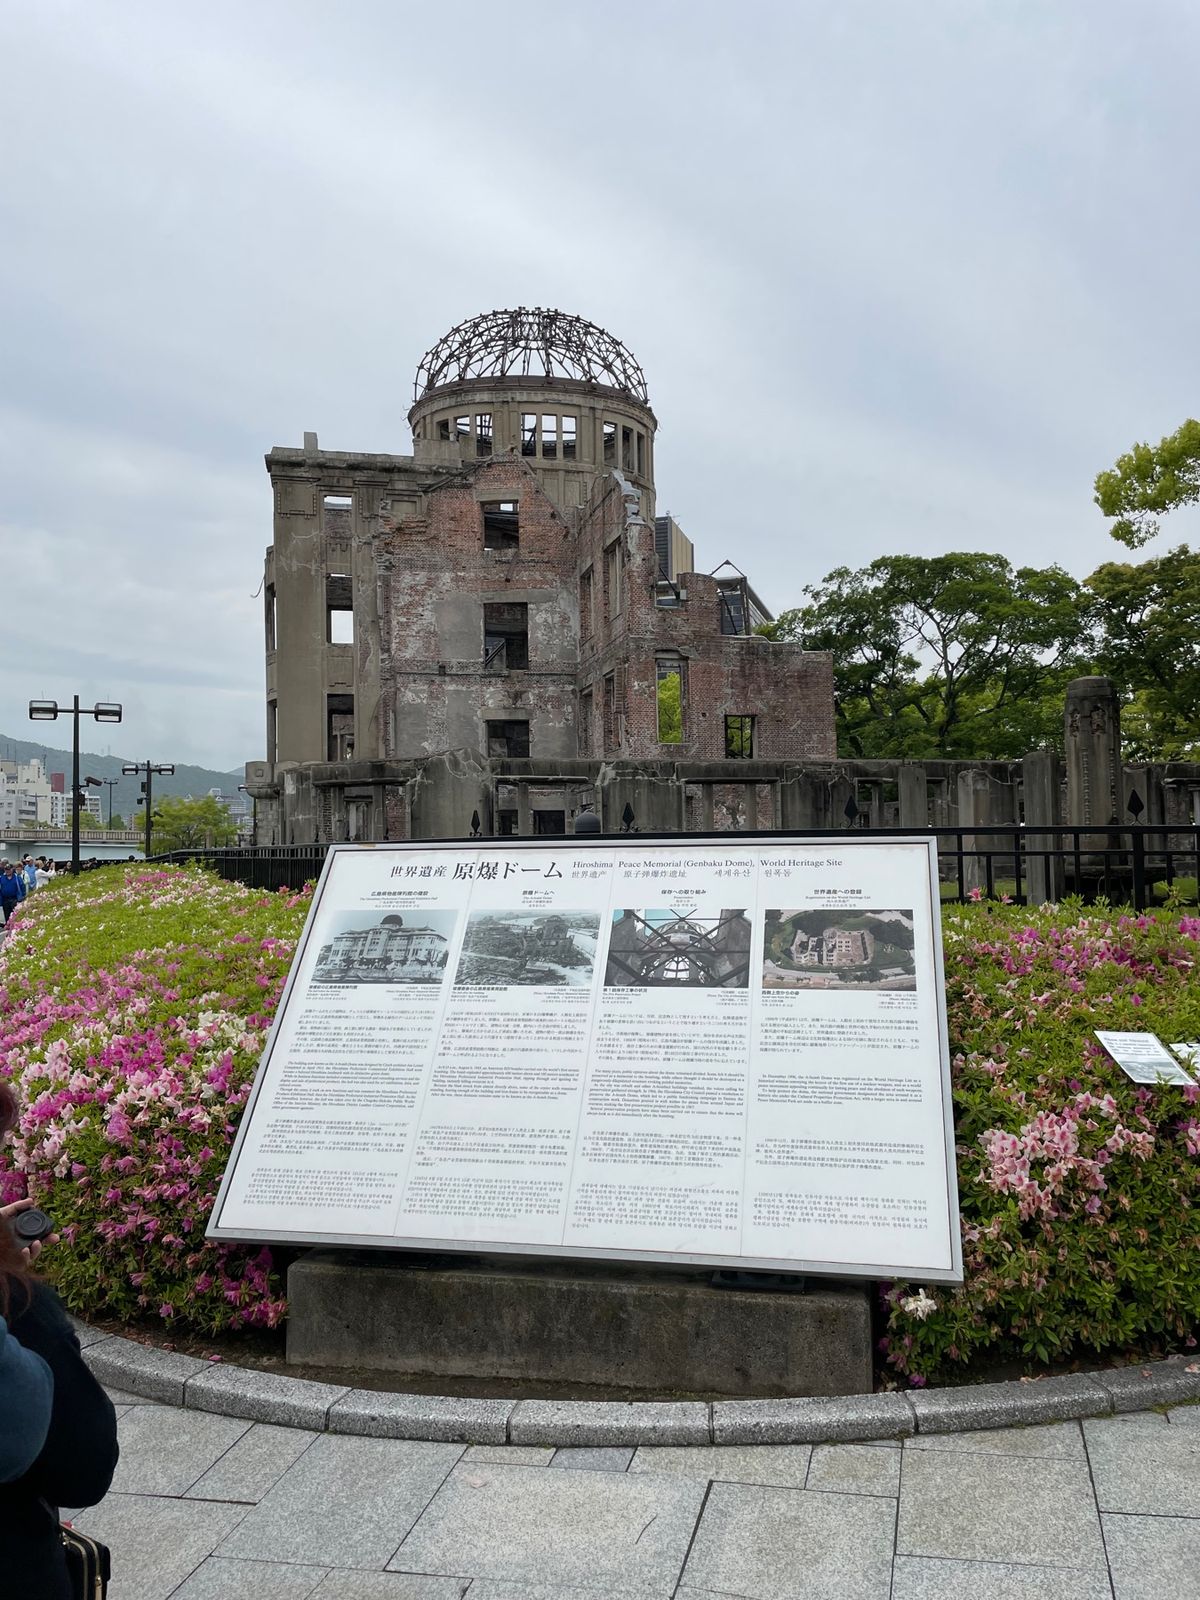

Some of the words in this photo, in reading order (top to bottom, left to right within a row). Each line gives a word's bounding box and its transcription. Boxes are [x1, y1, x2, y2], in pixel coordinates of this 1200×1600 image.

[390, 865, 447, 877] 世界遺産
[452, 861, 563, 880] 原爆ドーム
[643, 860, 682, 868] Memorial
[683, 859, 723, 868] (Genbaku
[760, 859, 785, 867] World
[787, 859, 824, 868] Heritage
[826, 859, 842, 867] Site
